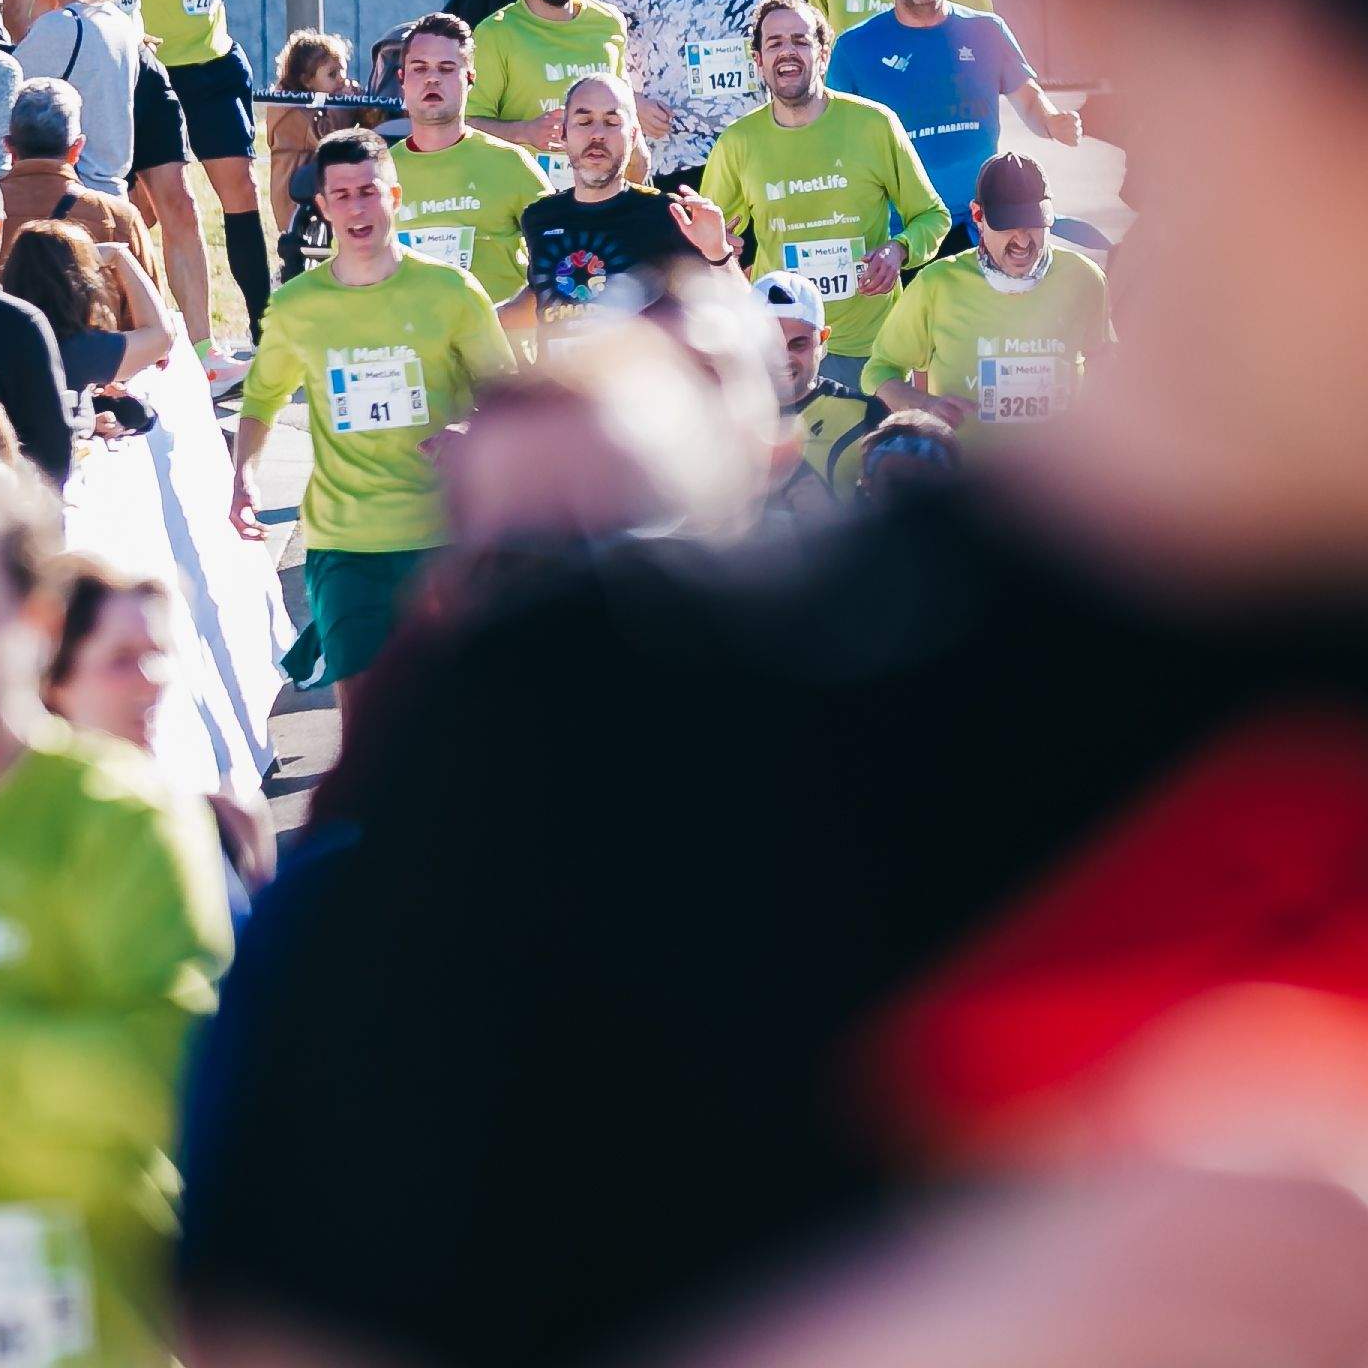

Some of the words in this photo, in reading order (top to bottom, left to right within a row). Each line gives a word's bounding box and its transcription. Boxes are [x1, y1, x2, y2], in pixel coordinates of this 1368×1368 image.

[708, 71, 742, 89] 1427
[937, 122, 980, 134] MARATHON
[788, 175, 848, 195] MetLife
[420, 195, 481, 214] MetLife
[427, 233, 457, 242] MetLife
[815, 245, 848, 256] MetLife
[1004, 337, 1065, 353] MetLife
[1016, 366, 1050, 375] MetLife
[370, 401, 391, 422] 41
[999, 396, 1050, 418] 3263
